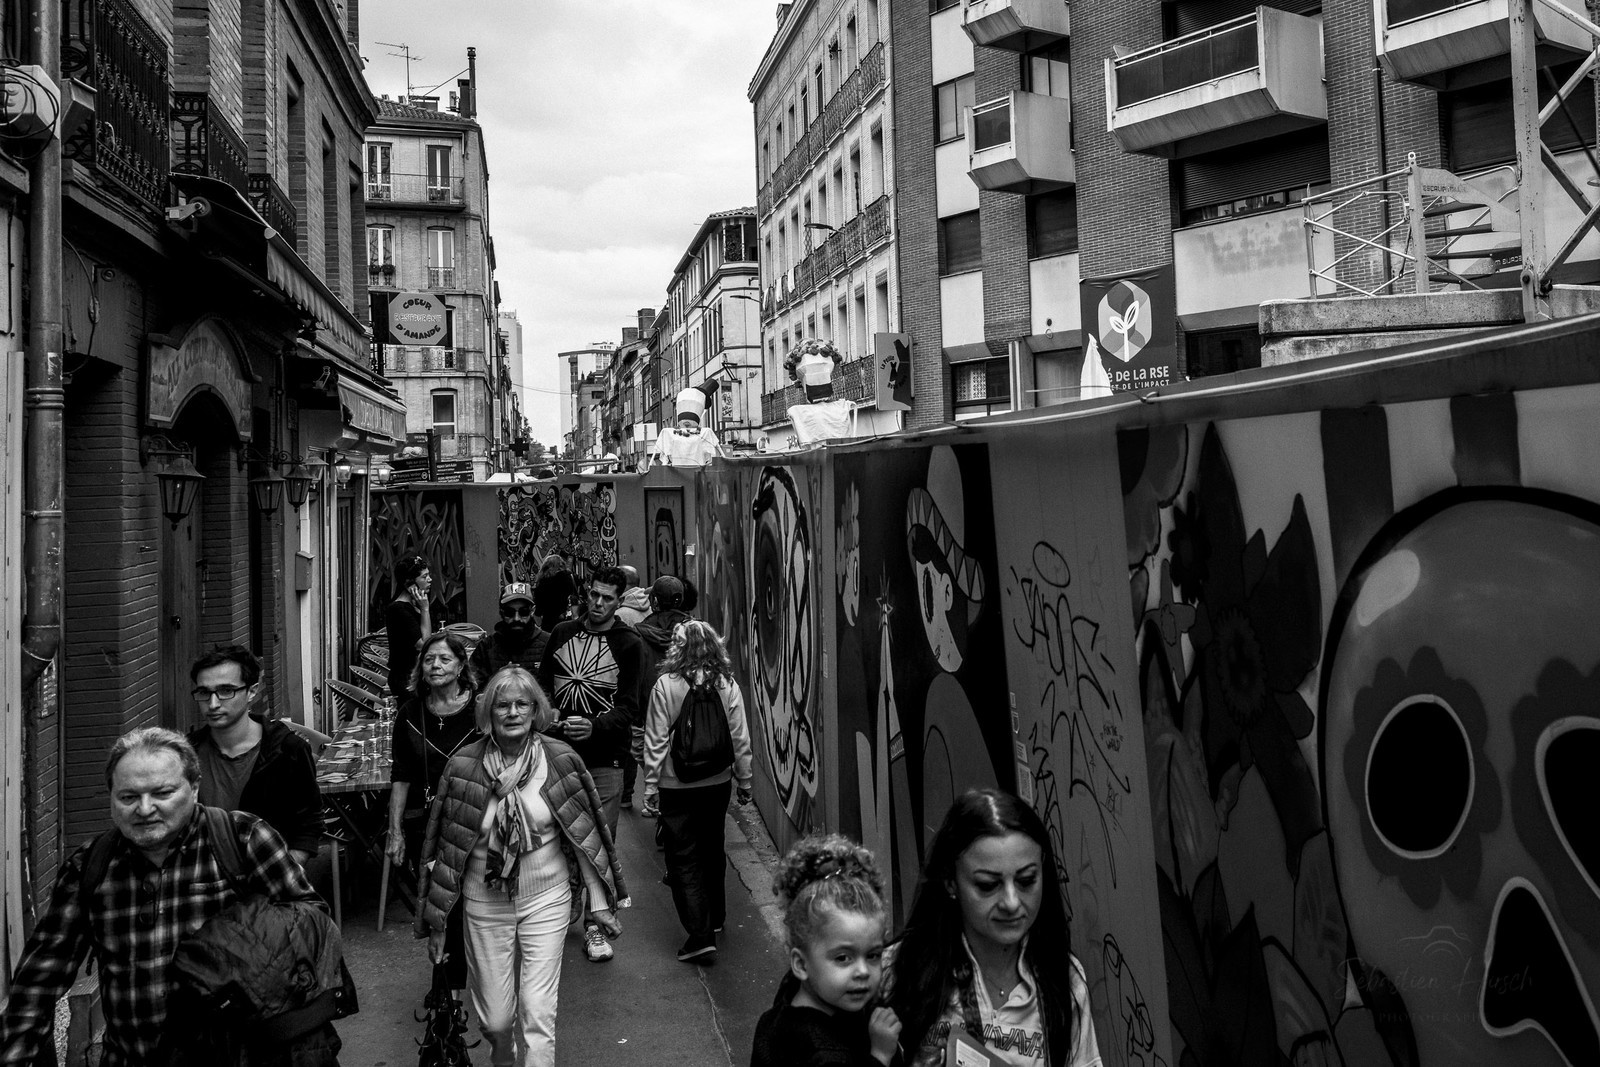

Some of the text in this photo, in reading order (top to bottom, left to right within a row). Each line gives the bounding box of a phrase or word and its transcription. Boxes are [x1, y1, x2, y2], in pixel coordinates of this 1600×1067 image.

[402, 298, 432, 311] COEUR
[395, 323, 441, 340] D'AMANDE
[1149, 365, 1170, 379] RSE
[1122, 382, 1132, 390] DE
[1134, 379, 1170, 389] L'IMPACT
